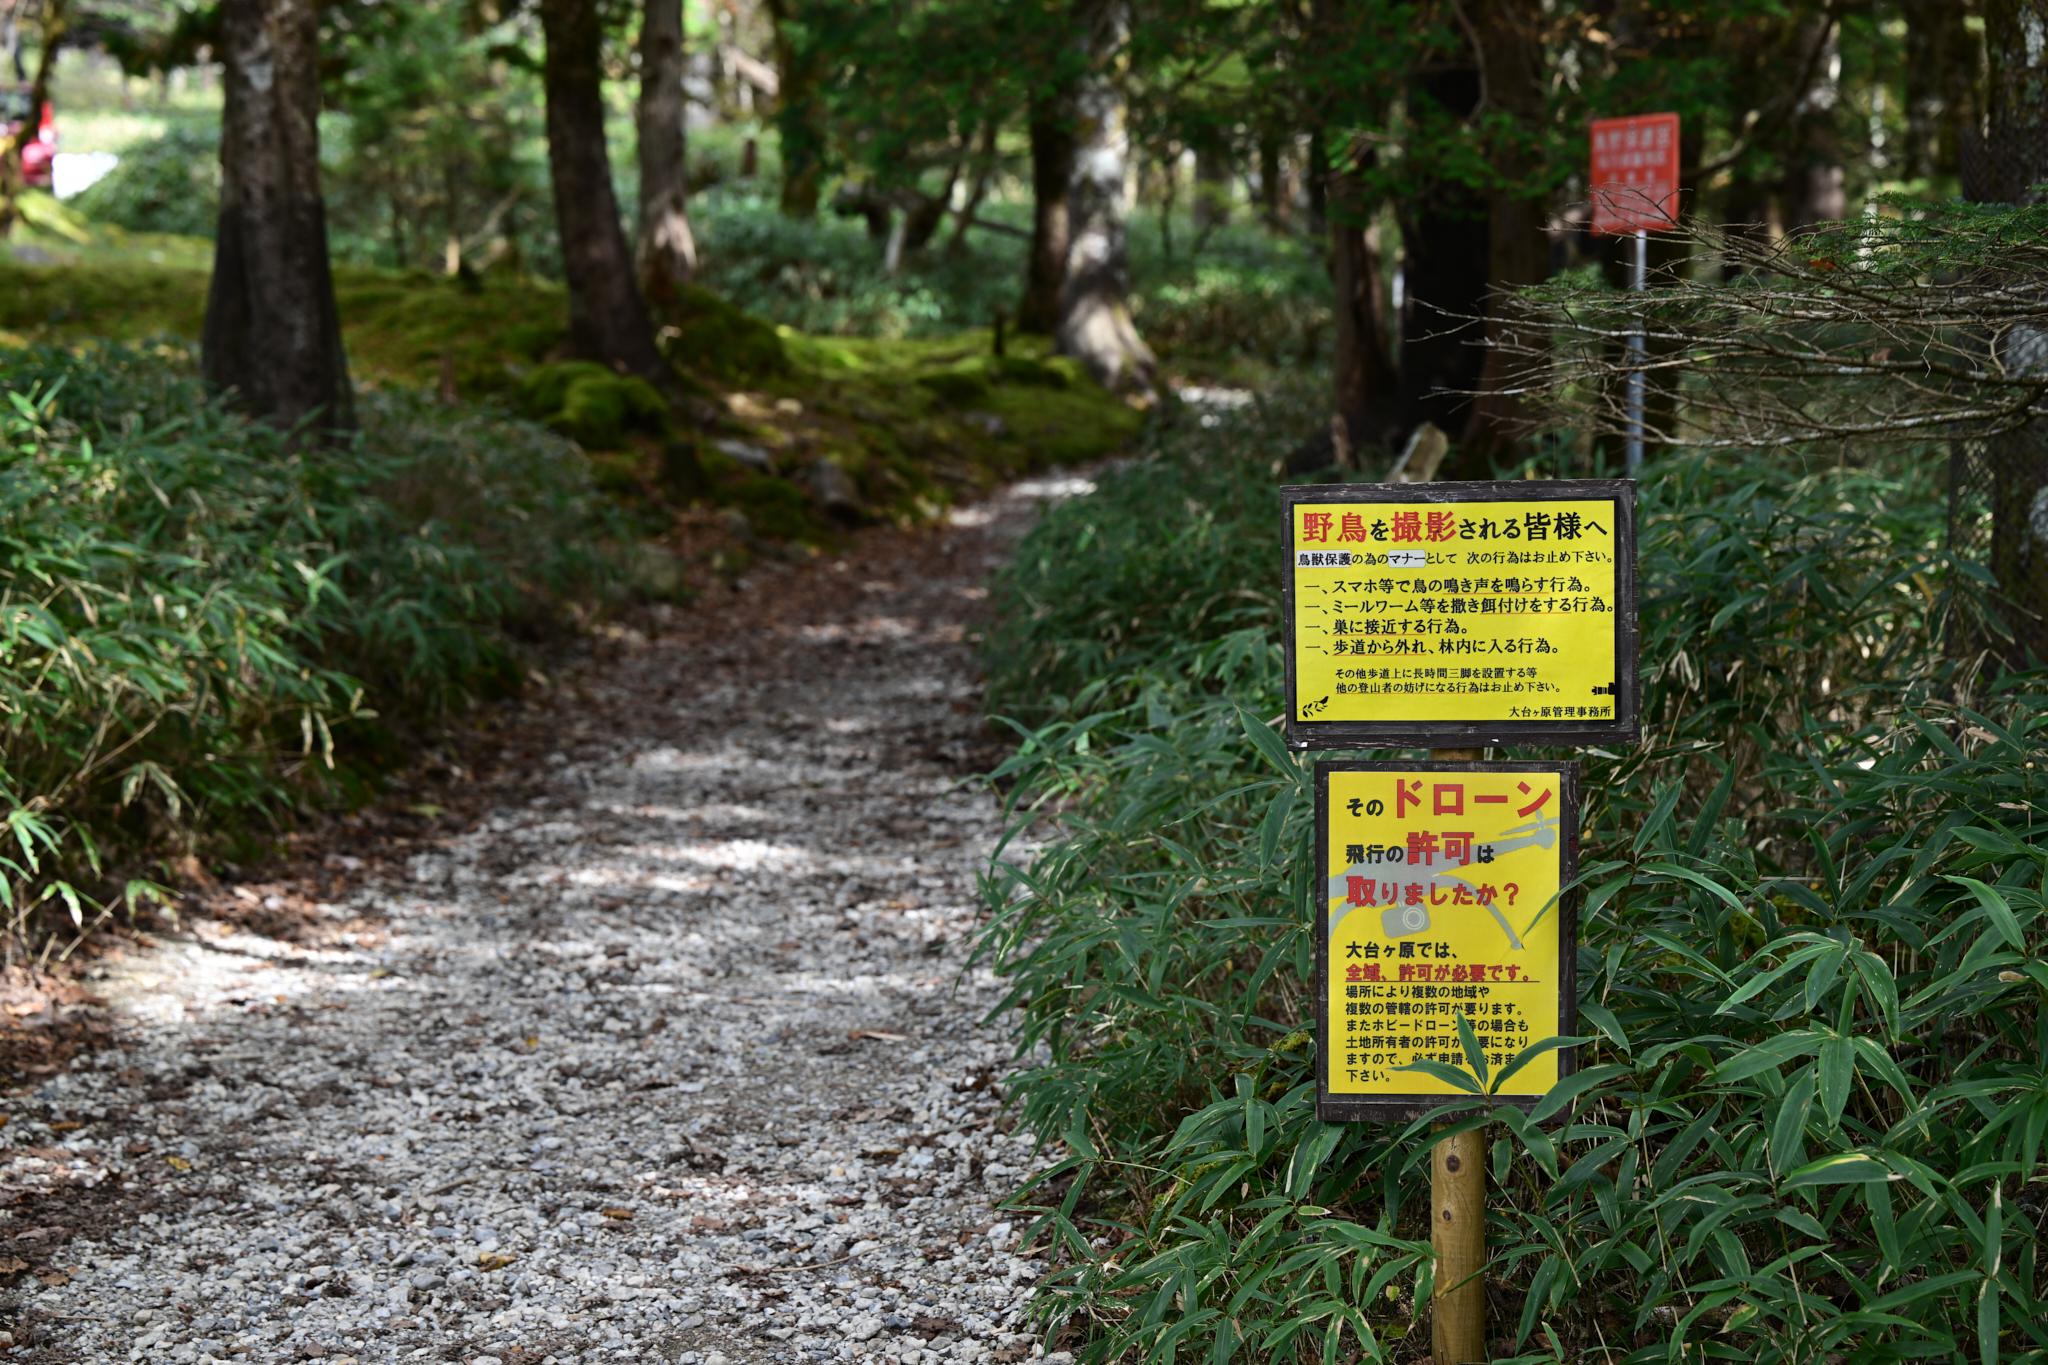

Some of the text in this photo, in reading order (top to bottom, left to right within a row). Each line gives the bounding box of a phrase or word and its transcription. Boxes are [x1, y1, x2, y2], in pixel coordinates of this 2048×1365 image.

[1303, 511, 1608, 542] 野鳥を撮影される皆様へ
[1298, 551, 1612, 566] 鳥獣保護の為のマナーとして 次の行為はお止め下さい。
[1304, 576, 1590, 594] 一、スマホ等で鳥の鳴き声を鳴らす行為。
[1305, 618, 1467, 634] 一、巣に接近する行為。
[1305, 637, 1558, 655] 一、歩道から外れ、林内に入る行為。
[1335, 667, 1537, 679] その他歩道上に長時間三脚を設置する等
[1336, 681, 1560, 693] 他の登山者の妨げになる行為はお止め下さい。
[1346, 831, 1495, 865] 飛行の許可は
[1346, 985, 1490, 998] 場所により複数の地域や
[1346, 1002, 1522, 1015] 複数の管轄の許可が要ります。
[1346, 1070, 1390, 1082] 下さい。
